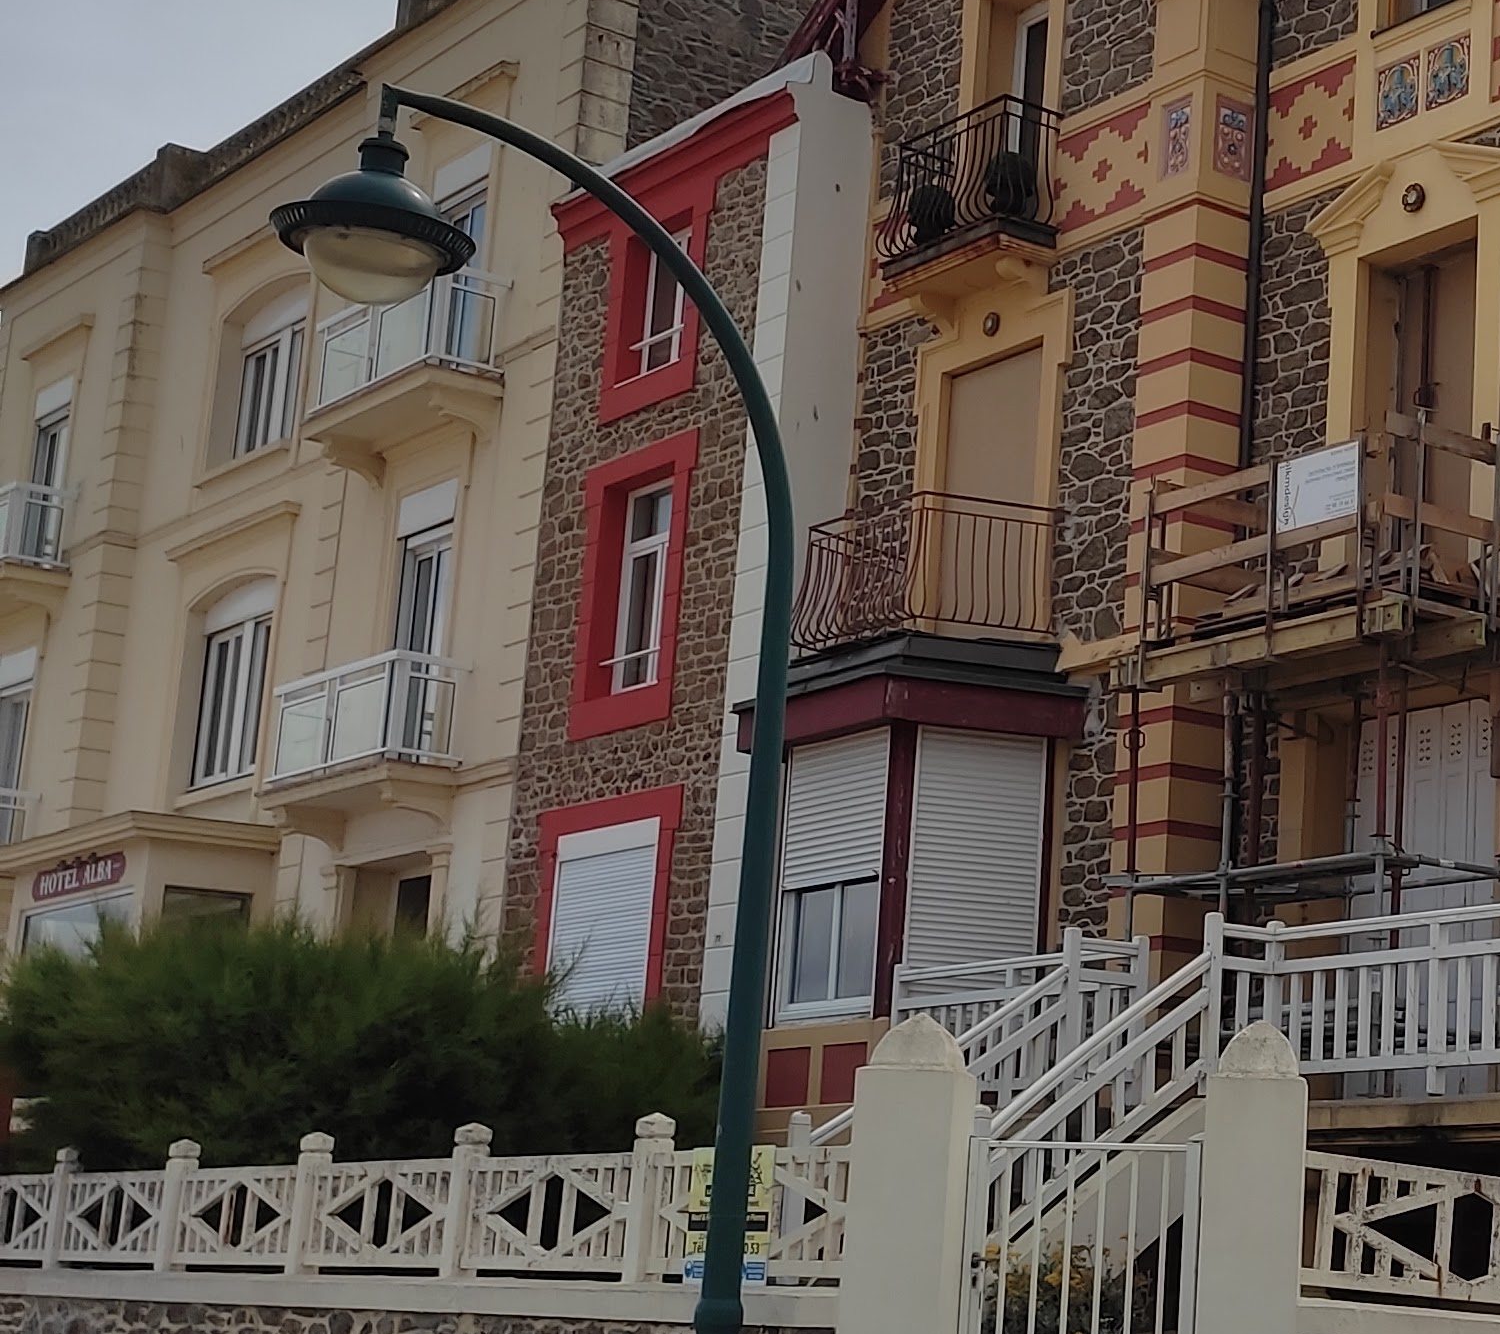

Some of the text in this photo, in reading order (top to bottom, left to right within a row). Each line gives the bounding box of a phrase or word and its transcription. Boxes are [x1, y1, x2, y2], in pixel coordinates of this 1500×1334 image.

[40, 859, 112, 896] HOTEL ALBA
[750, 1242, 760, 1255] 53
